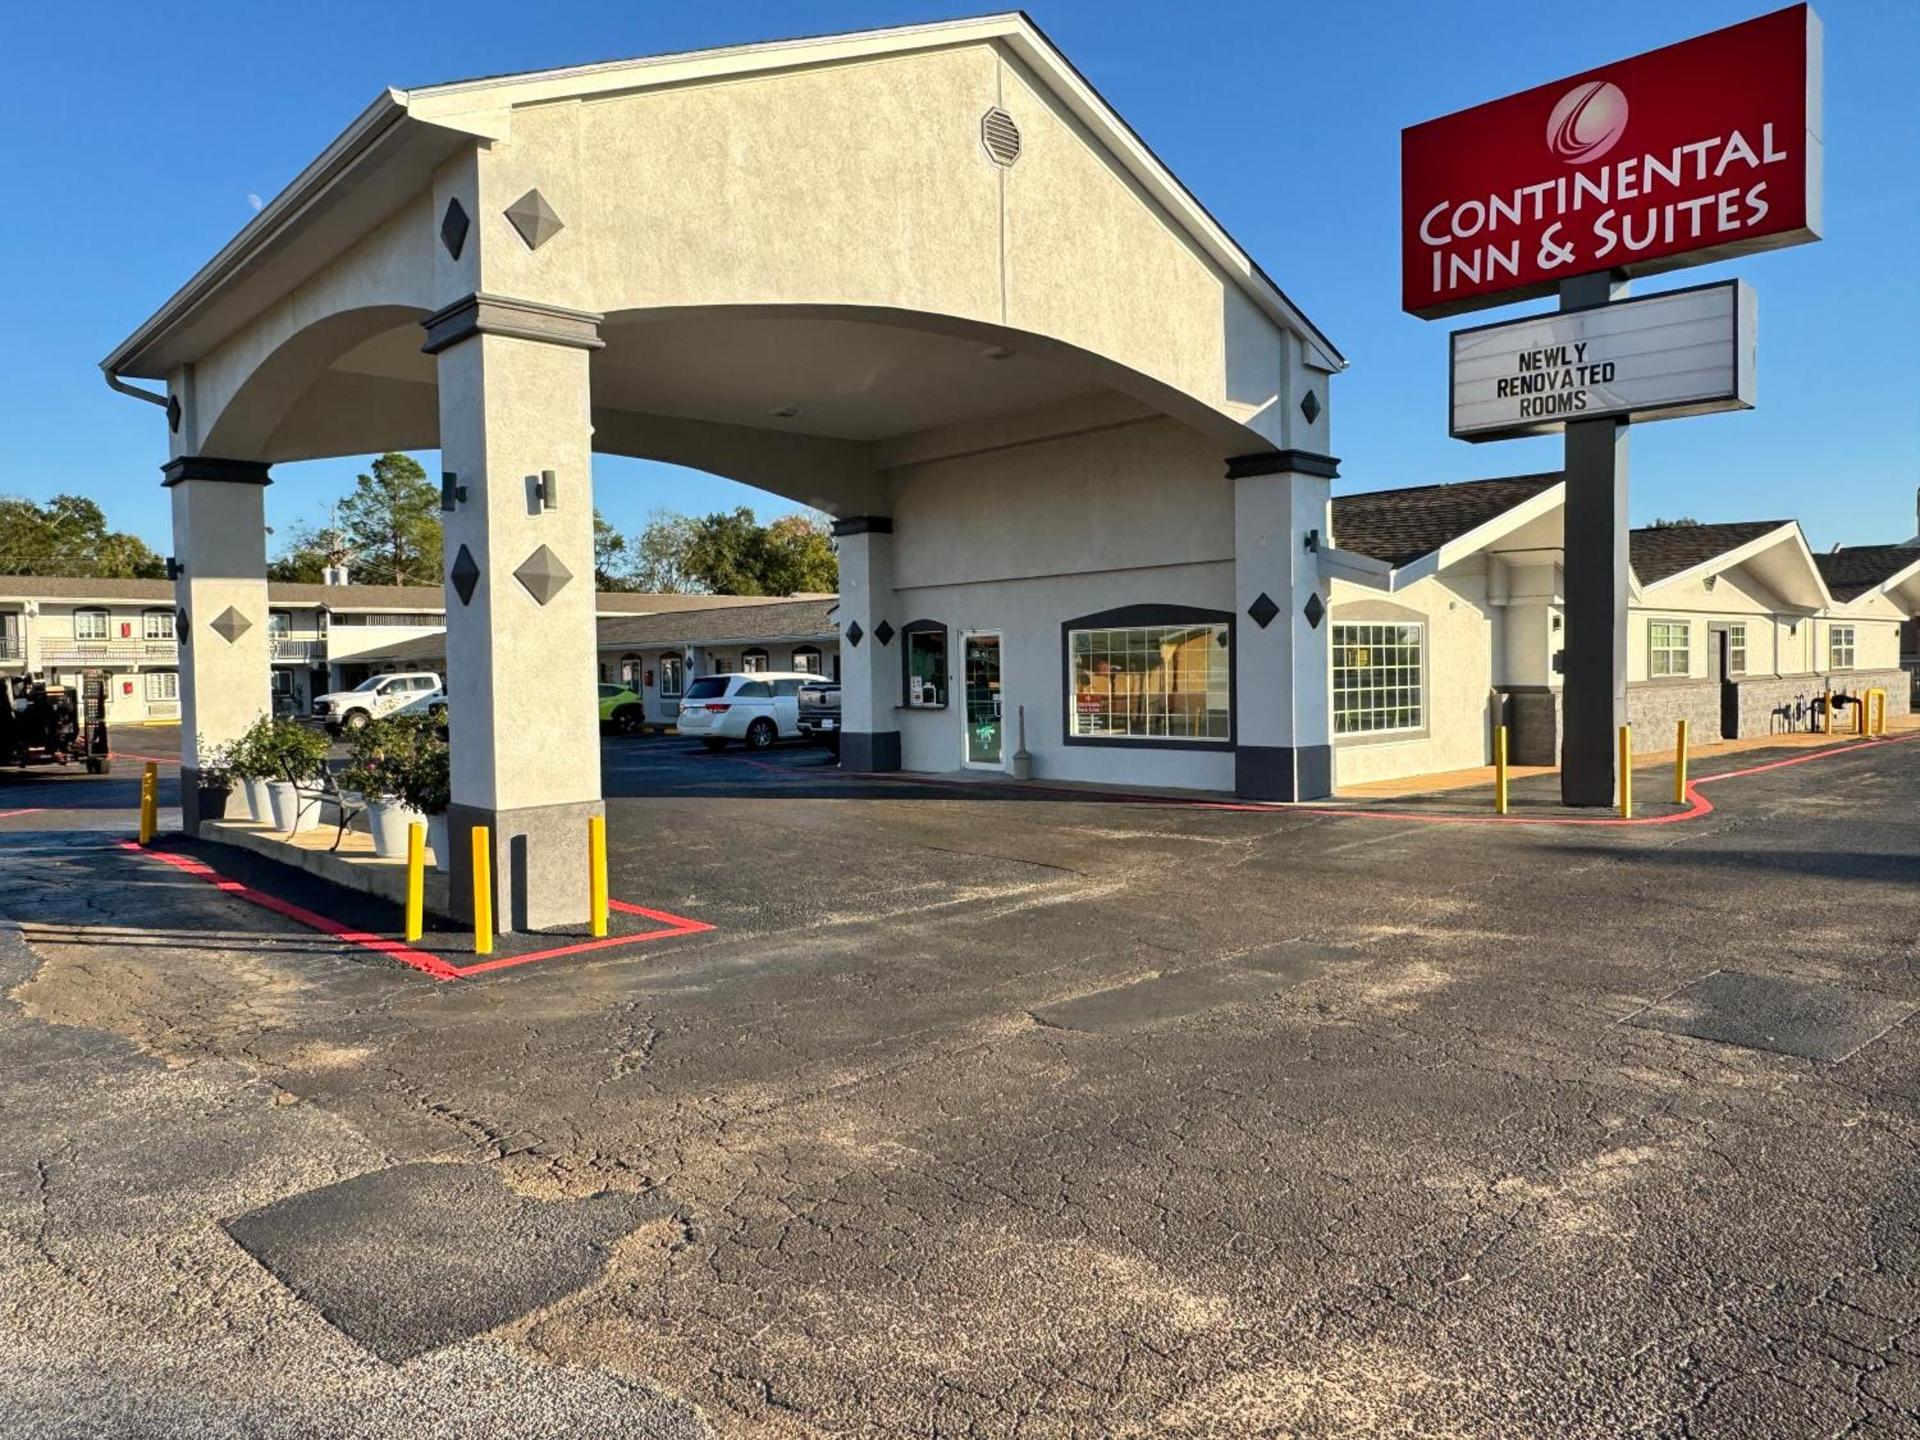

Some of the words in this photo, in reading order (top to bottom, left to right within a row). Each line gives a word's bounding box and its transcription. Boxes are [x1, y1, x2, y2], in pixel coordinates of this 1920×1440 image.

[1419, 122, 1787, 246] CONTINENTAL
[1432, 240, 1520, 292] INN
[1536, 221, 1576, 270] &
[1593, 181, 1770, 259] SUITES
[1519, 342, 1588, 372] NEWLY
[1497, 362, 1616, 398] RENOVATED
[1520, 389, 1587, 418] ROOMS
